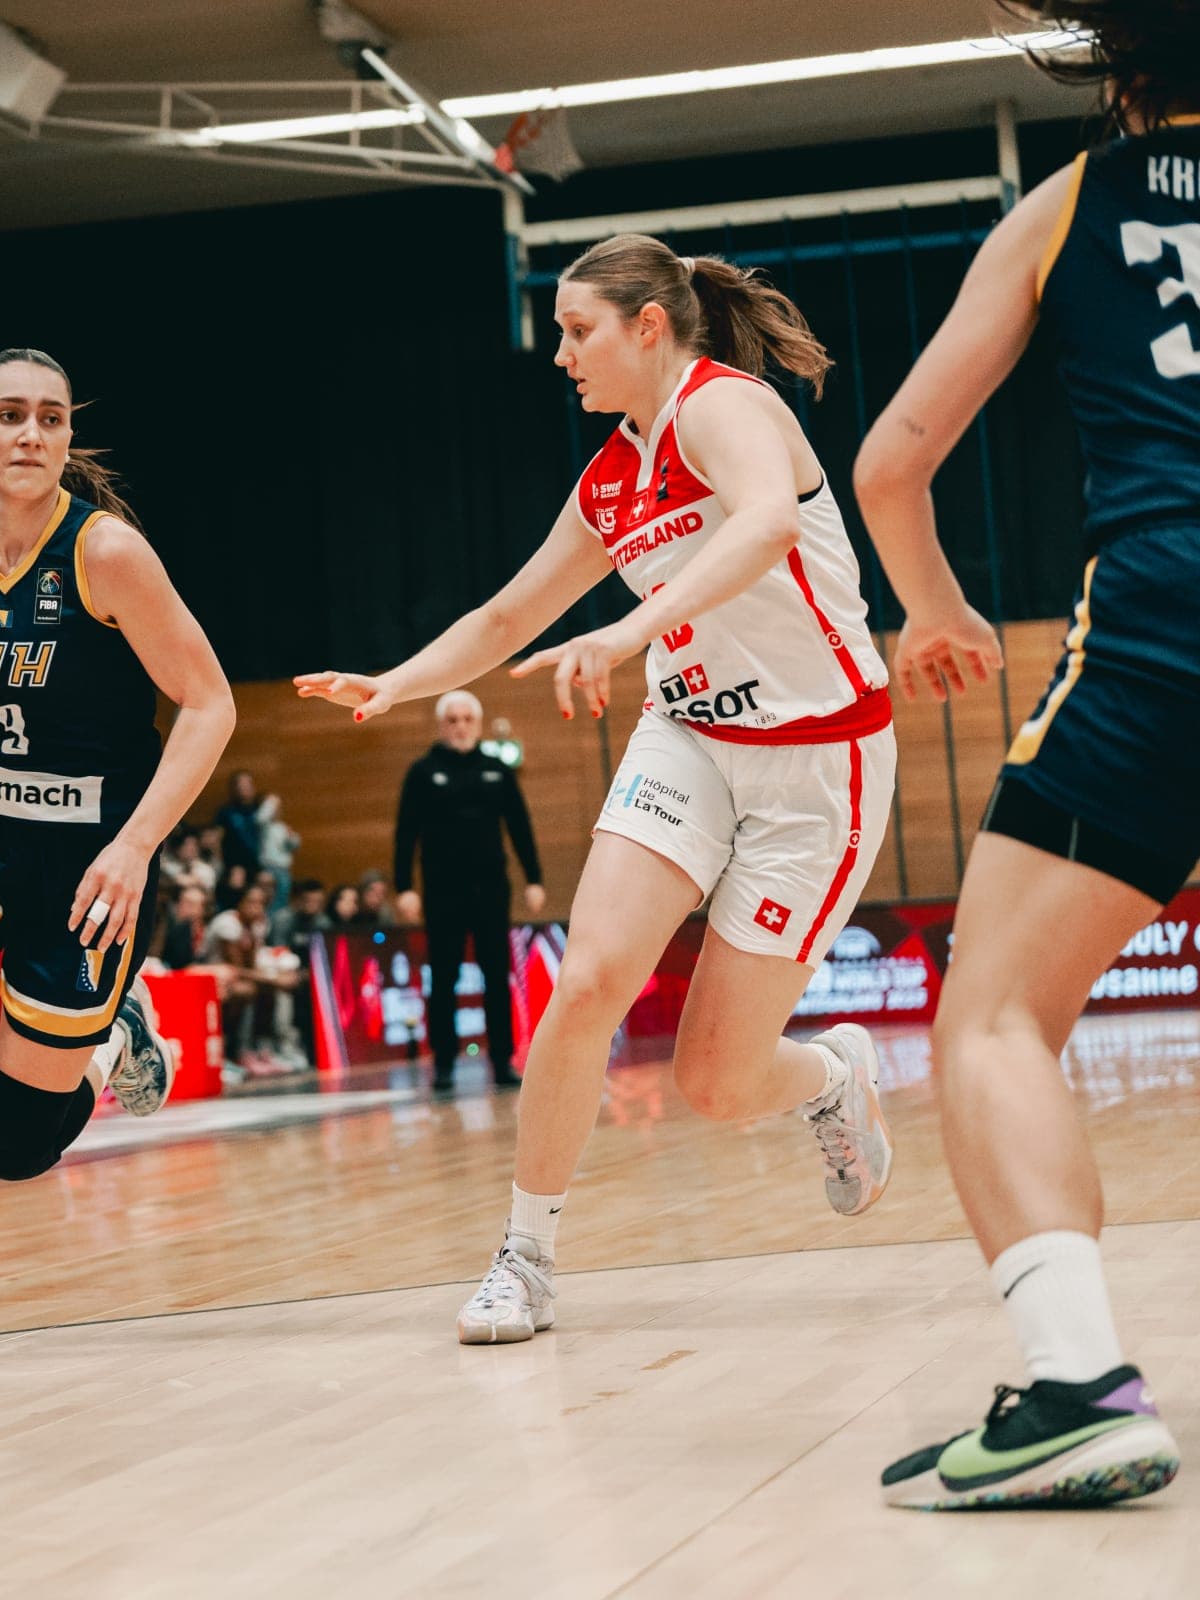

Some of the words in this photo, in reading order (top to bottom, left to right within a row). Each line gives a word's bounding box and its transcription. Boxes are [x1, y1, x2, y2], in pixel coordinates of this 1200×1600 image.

[1147, 154, 1200, 201] KR
[39, 599, 58, 610] FIBA
[663, 680, 759, 725] SOT
[639, 789, 656, 801] de
[643, 777, 690, 805] Hôpital
